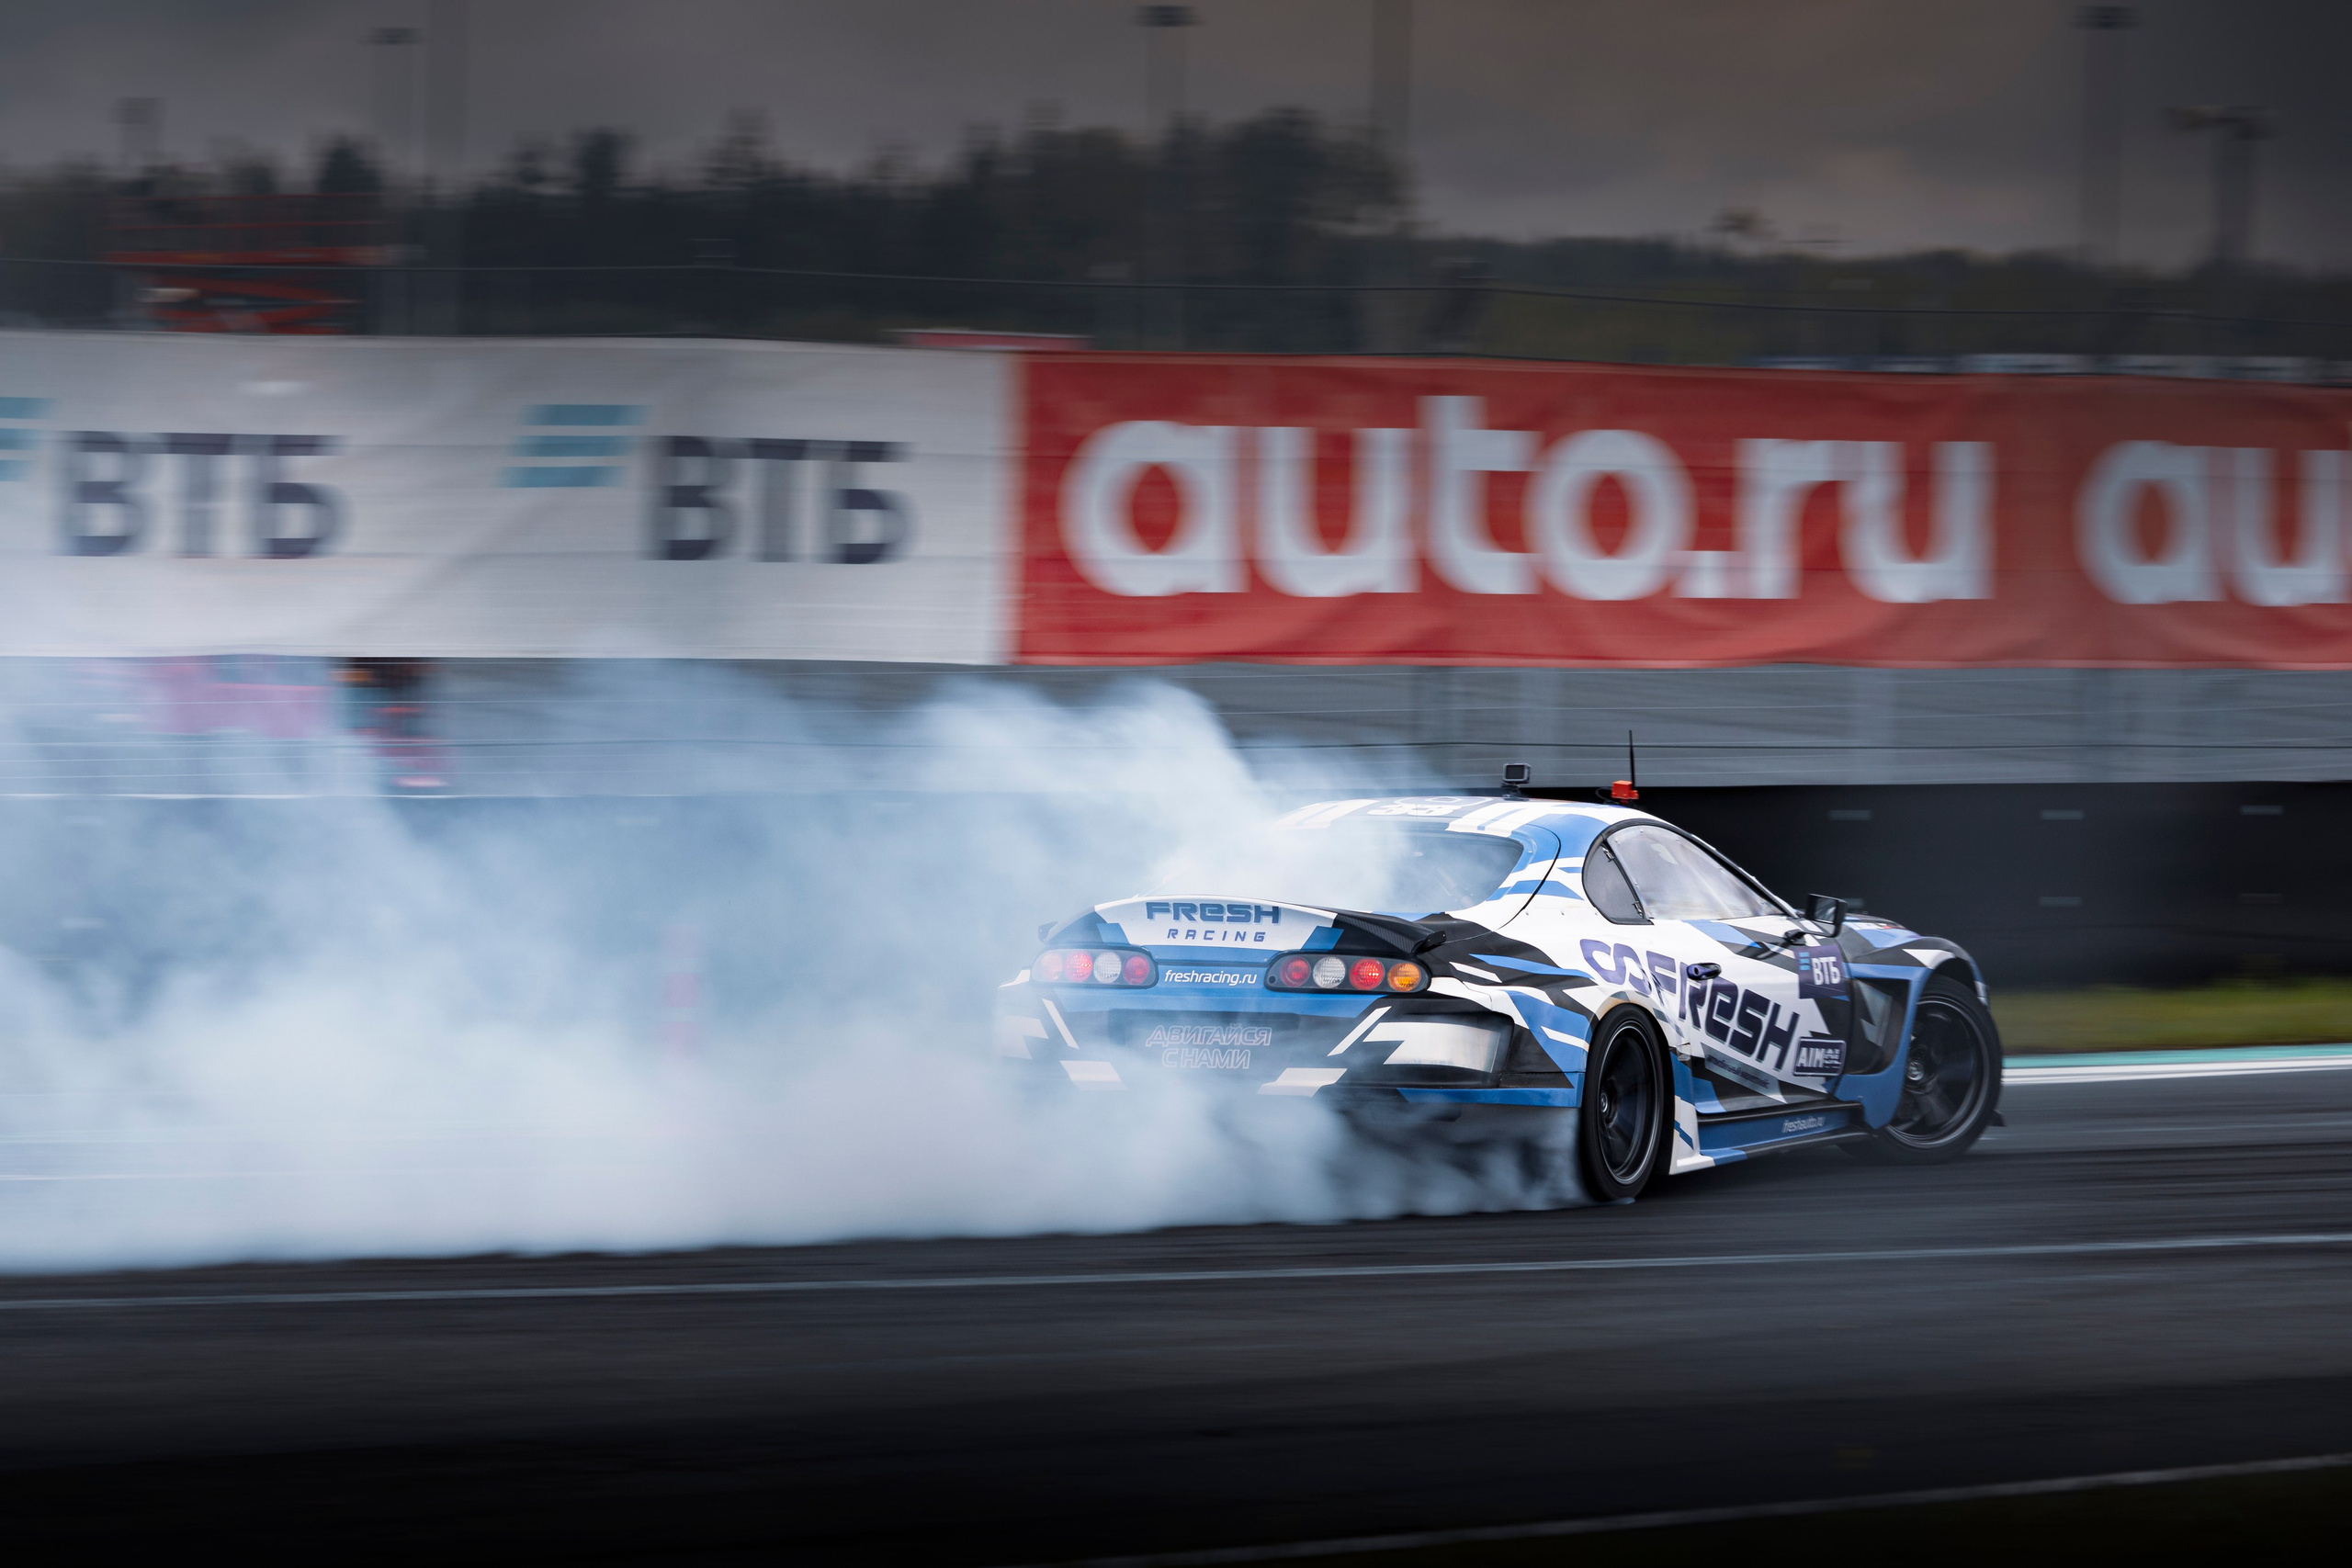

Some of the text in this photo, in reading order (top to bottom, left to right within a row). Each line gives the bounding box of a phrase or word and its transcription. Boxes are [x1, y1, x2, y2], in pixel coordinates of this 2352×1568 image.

[60, 431, 346, 558] ВТБ
[646, 435, 914, 564] ВТБ
[1059, 394, 1996, 604] auto.ru
[2073, 439, 2352, 607] au
[1167, 928, 1266, 942] RACING
[1164, 969, 1258, 987] freshracing.ru
[1811, 956, 1841, 986] ВТБ
[1145, 1023, 1272, 1047] ДВИГАЙСЯ
[1161, 1047, 1251, 1069] С НАМИ
